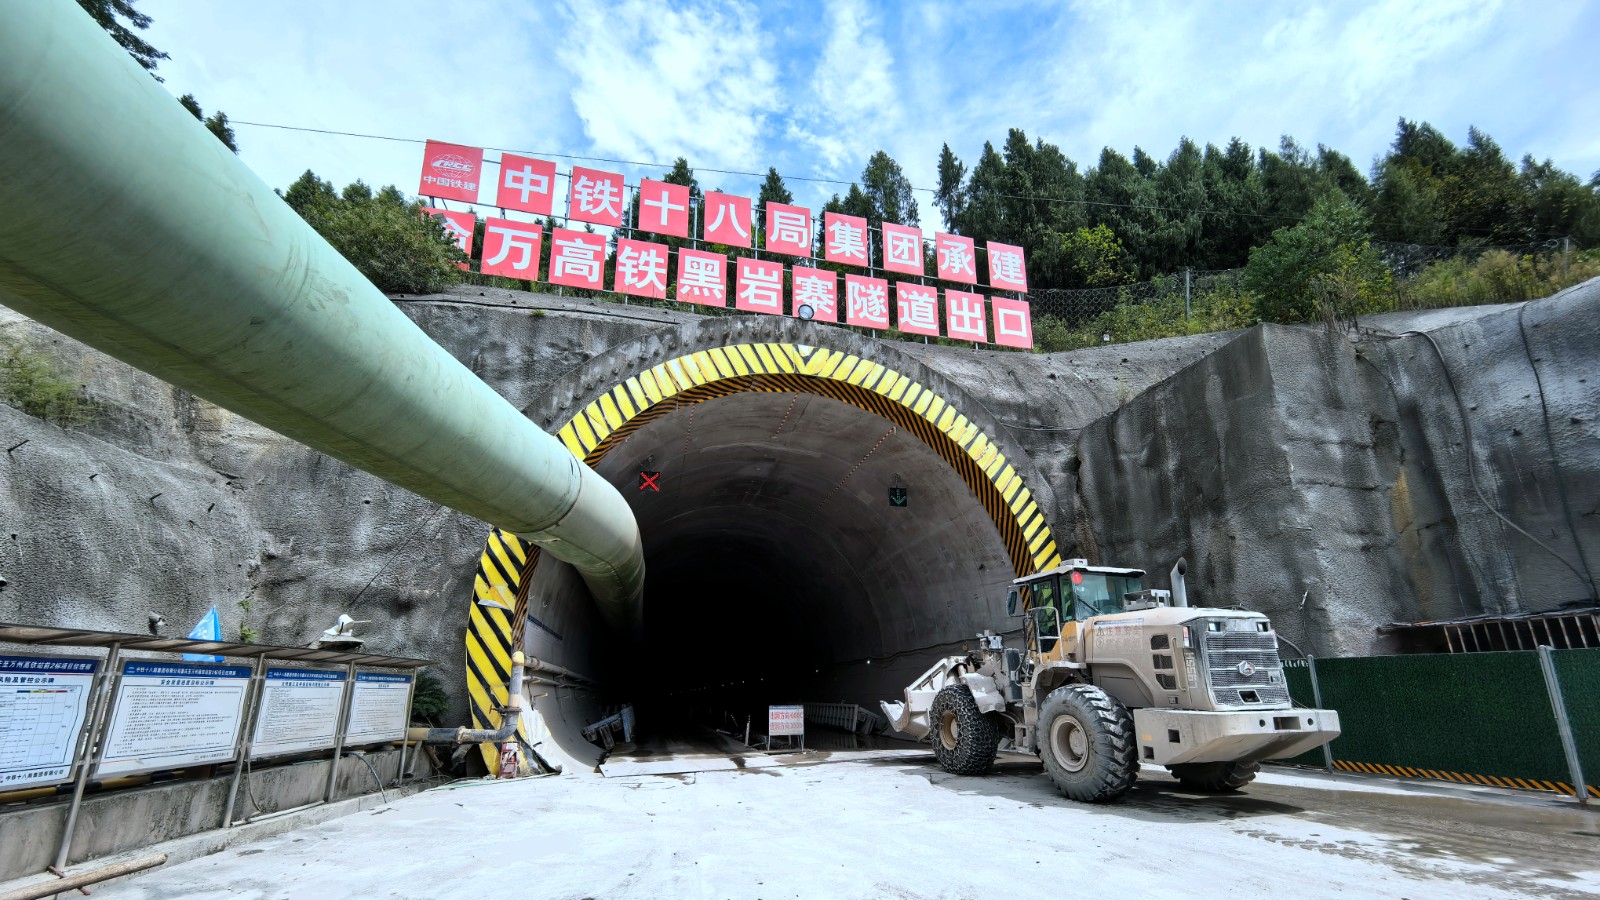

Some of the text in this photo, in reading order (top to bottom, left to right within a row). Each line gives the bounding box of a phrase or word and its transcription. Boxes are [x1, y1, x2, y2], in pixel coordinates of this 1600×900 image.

[424, 175, 477, 192] 中国铁建
[504, 165, 1025, 285] 中铁十八局集团承建
